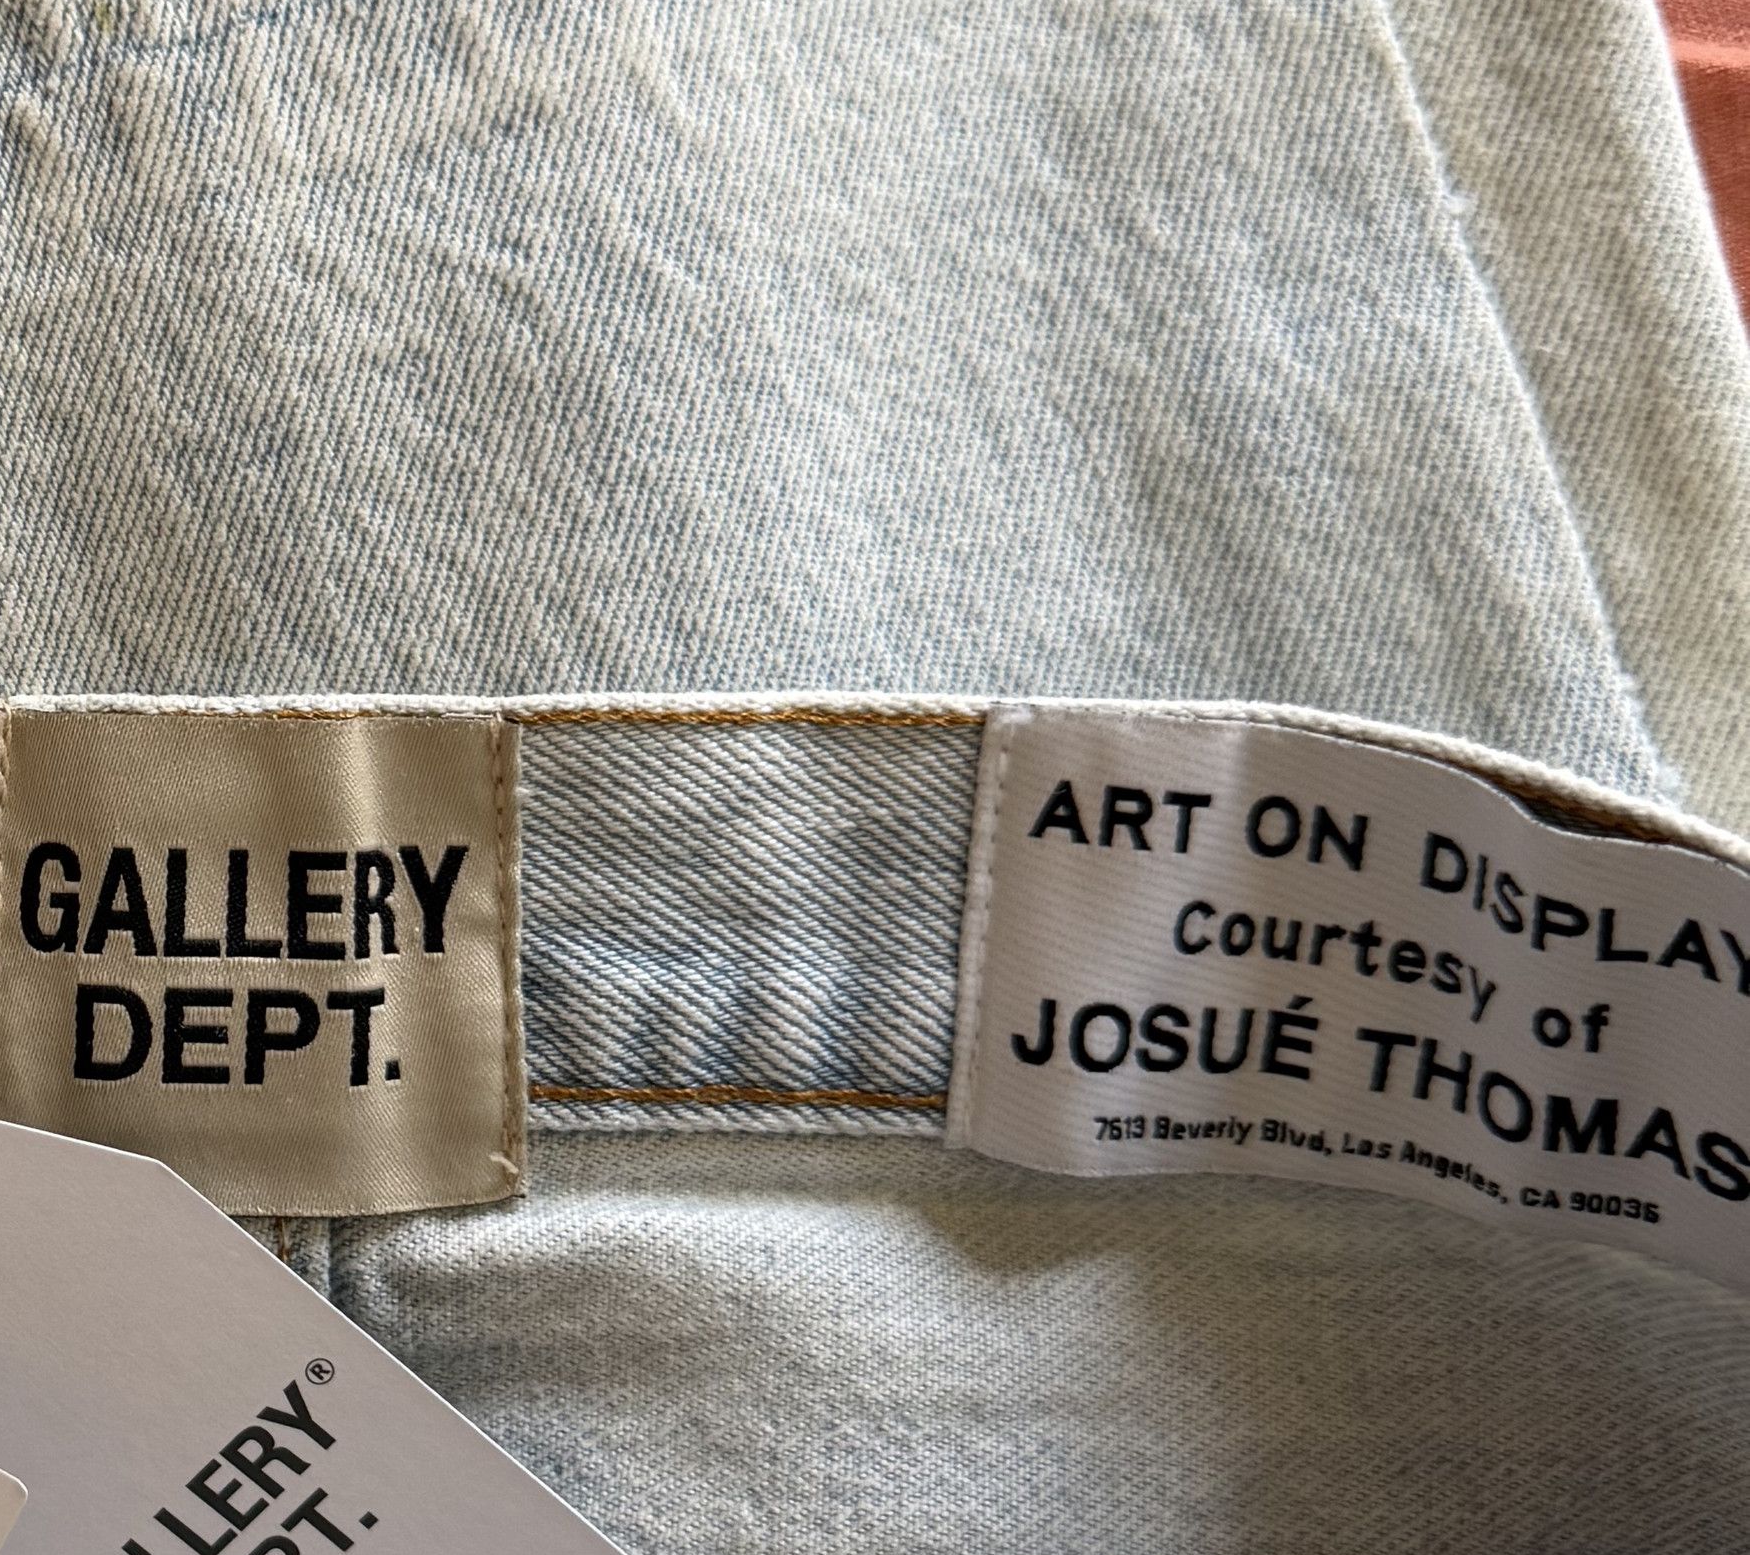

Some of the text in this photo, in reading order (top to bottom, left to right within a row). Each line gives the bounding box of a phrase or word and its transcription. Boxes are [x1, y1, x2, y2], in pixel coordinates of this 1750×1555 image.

[20, 841, 469, 961] GALLERY
[1027, 779, 1750, 997] ART ON DISPLAY
[73, 983, 402, 1086] DEPT.
[1174, 899, 1610, 1054] Courtesy of
[1010, 995, 1750, 1202] JOSUÉ THOMAS
[1153, 1115, 1252, 1145] Beverly
[1340, 1131, 1393, 1160] Los
[1399, 1139, 1509, 1205] Angeles,
[1518, 1186, 1562, 1211] CA
